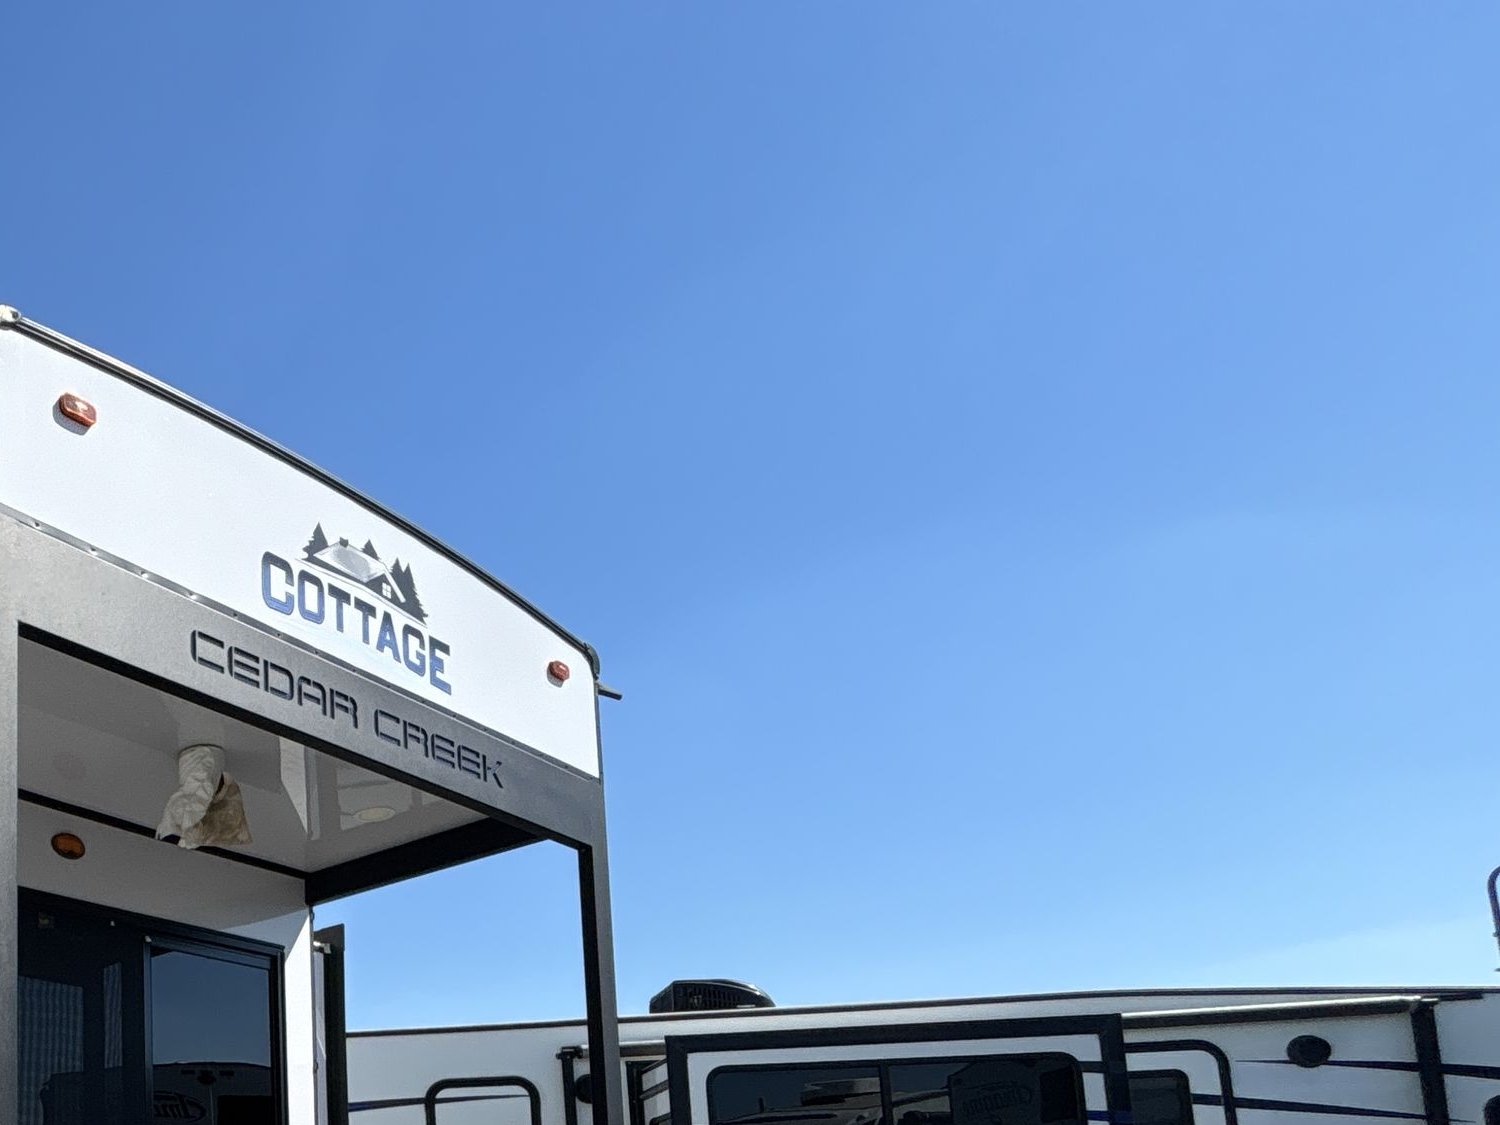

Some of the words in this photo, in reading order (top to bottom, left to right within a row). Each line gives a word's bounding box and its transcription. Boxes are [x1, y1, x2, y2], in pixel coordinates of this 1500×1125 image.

[261, 551, 452, 695] COTTAGE
[191, 629, 359, 729] CEDAR
[374, 708, 504, 789] CREEK
